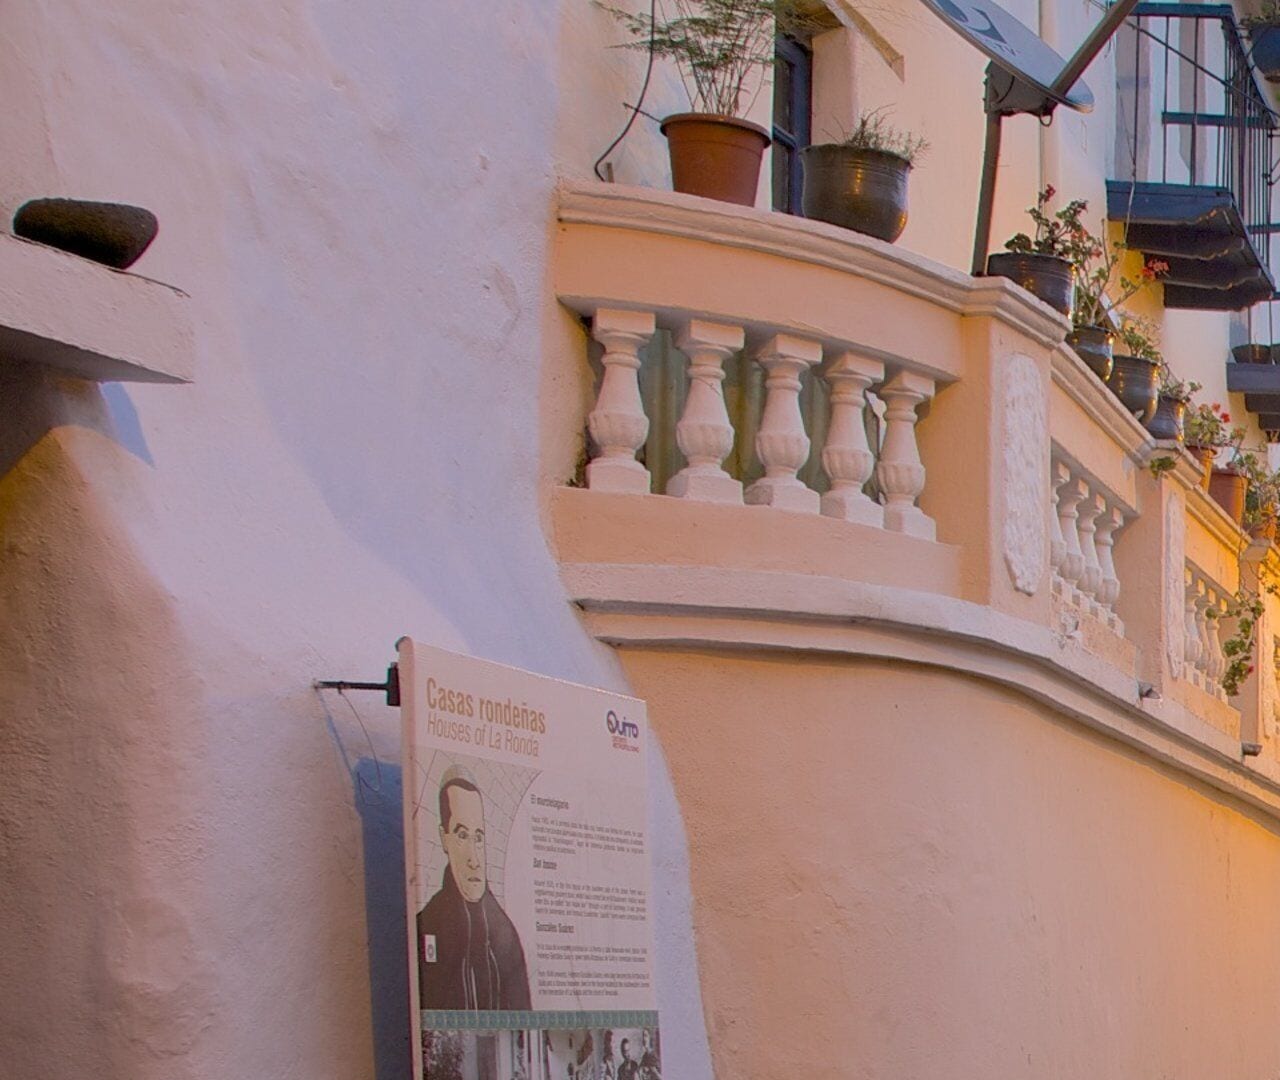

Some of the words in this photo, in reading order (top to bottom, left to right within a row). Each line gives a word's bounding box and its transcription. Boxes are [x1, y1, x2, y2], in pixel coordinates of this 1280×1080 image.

[426, 677, 474, 718] Casas
[479, 697, 546, 734] rondeñas
[606, 710, 639, 739] Quito
[427, 712, 471, 744] Houses
[474, 724, 487, 746] of
[488, 725, 501, 750] La
[504, 729, 540, 757] Ronda
